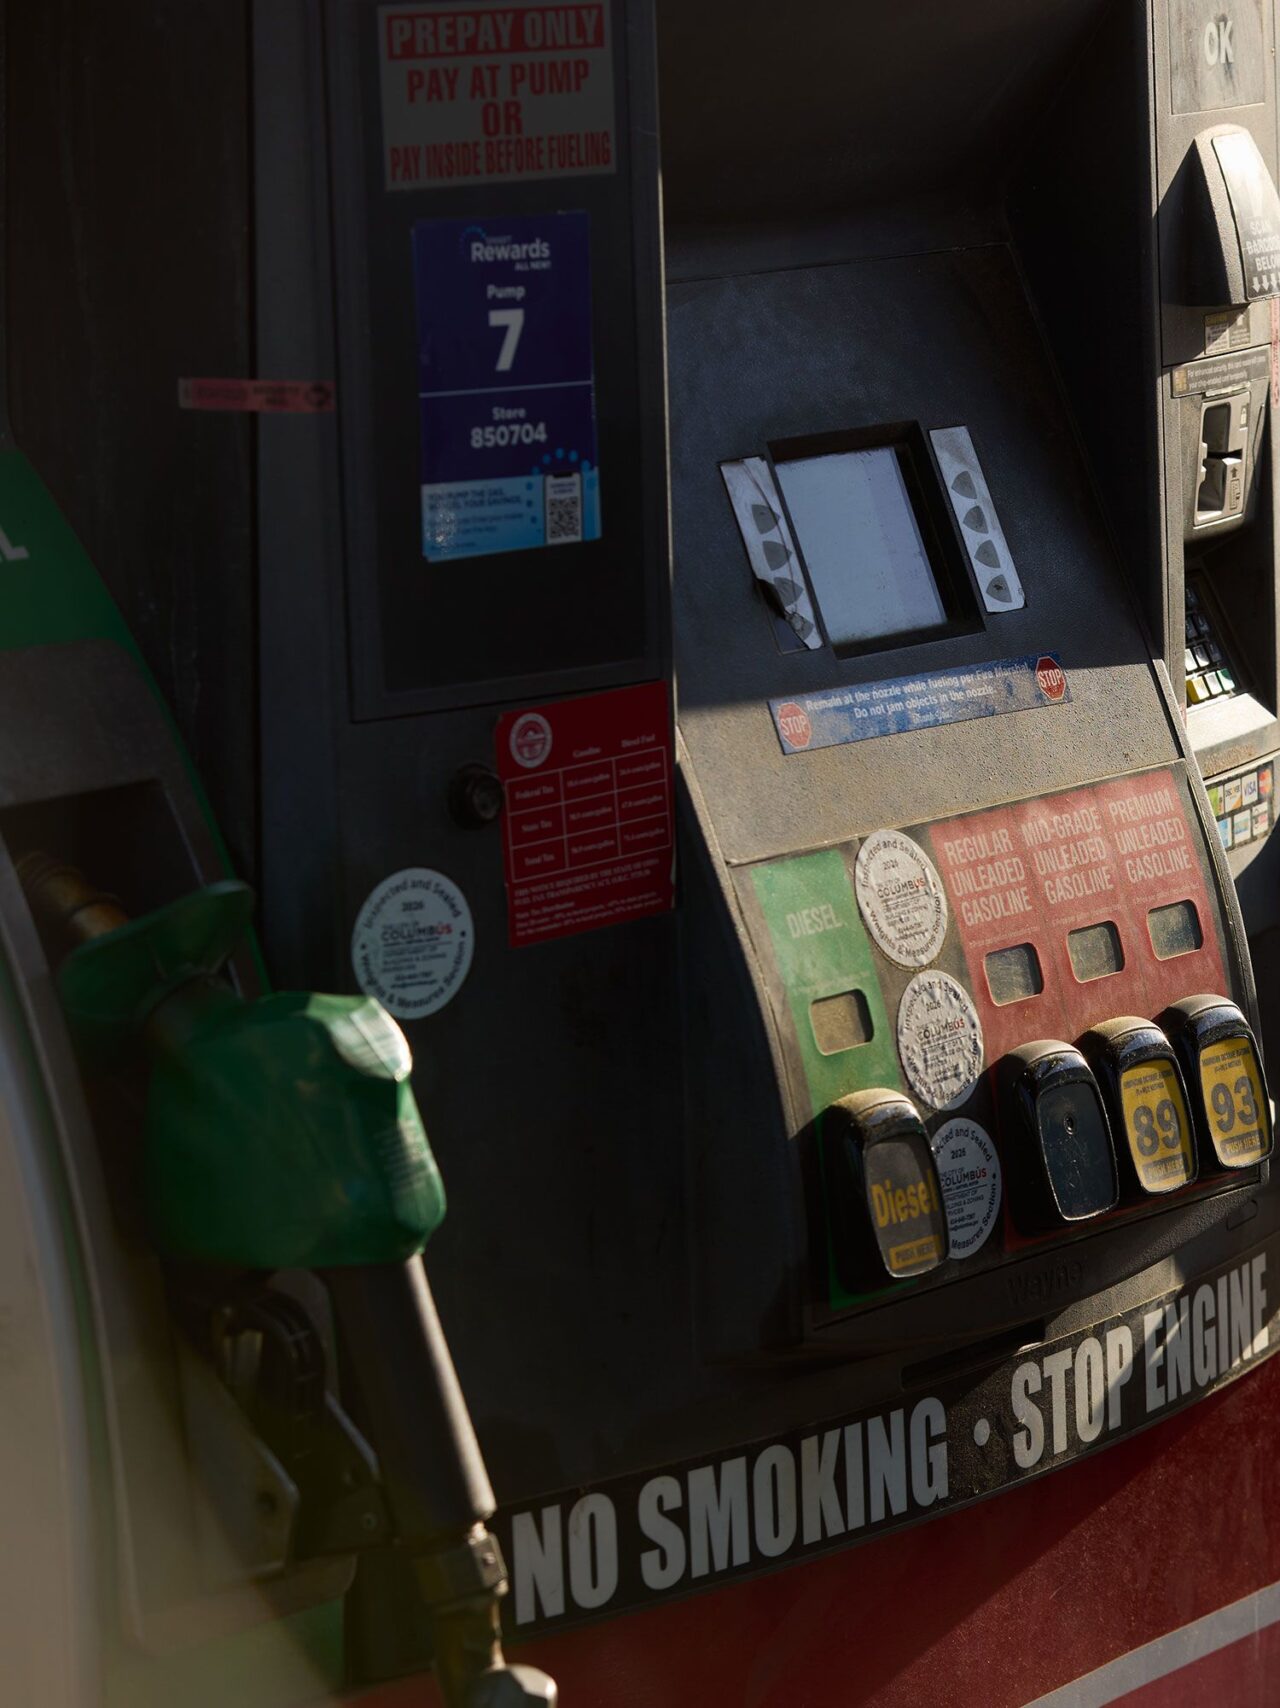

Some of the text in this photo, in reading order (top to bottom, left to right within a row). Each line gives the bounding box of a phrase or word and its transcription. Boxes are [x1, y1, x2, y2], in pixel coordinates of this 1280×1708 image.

[391, 8, 600, 57] PREPAY ONLY
[1203, 20, 1235, 66] OK
[406, 58, 591, 103] PAY AT PUMP
[482, 100, 522, 137] OR
[390, 131, 612, 182] PAY INSIDE BEFORE FUELING
[470, 237, 551, 264] Rewards
[486, 283, 527, 302] Pump
[488, 308, 525, 371] 7
[492, 406, 526, 421] Store
[470, 422, 548, 449] 850704
[805, 696, 843, 711] Remain
[843, 693, 853, 704] at
[855, 690, 871, 702] the
[872, 686, 901, 700] nozzle
[903, 681, 927, 696] while
[928, 676, 960, 690] fueling
[960, 674, 975, 686] per
[1037, 668, 1063, 688] STOP
[854, 707, 868, 719] Do
[870, 704, 886, 716] not
[887, 701, 905, 716] jam
[906, 696, 938, 711] objects
[939, 693, 949, 704] in
[949, 691, 965, 702] the
[780, 714, 807, 736] STOP
[1108, 788, 1175, 826] PREMIUM
[882, 838, 898, 850] and
[1020, 806, 1103, 848] MID-GRADE
[1114, 816, 1186, 855] UNLEADED
[943, 828, 1014, 866] REGULAR
[1033, 836, 1108, 876] UNLEADED
[1125, 845, 1193, 884] GASOLINE
[410, 879, 433, 891] and
[877, 877, 926, 899] COLUMBUS
[950, 856, 1026, 897] UNLEADED
[1044, 865, 1114, 905] GASOLINE
[785, 903, 844, 938] DIESEL
[932, 891, 942, 934] Section
[961, 886, 1033, 927] GASOLINE
[381, 922, 453, 942] COLUMBUS
[1210, 1076, 1260, 1133] 93
[954, 1126, 970, 1138] and
[970, 1130, 993, 1162] Sealed
[1132, 1098, 1183, 1157] 89
[871, 1169, 939, 1228] Diesel
[950, 1225, 984, 1250] Measures
[982, 1182, 996, 1226] Section
[510, 1252, 1270, 1627] NO SMOKING STOP ENGINE
